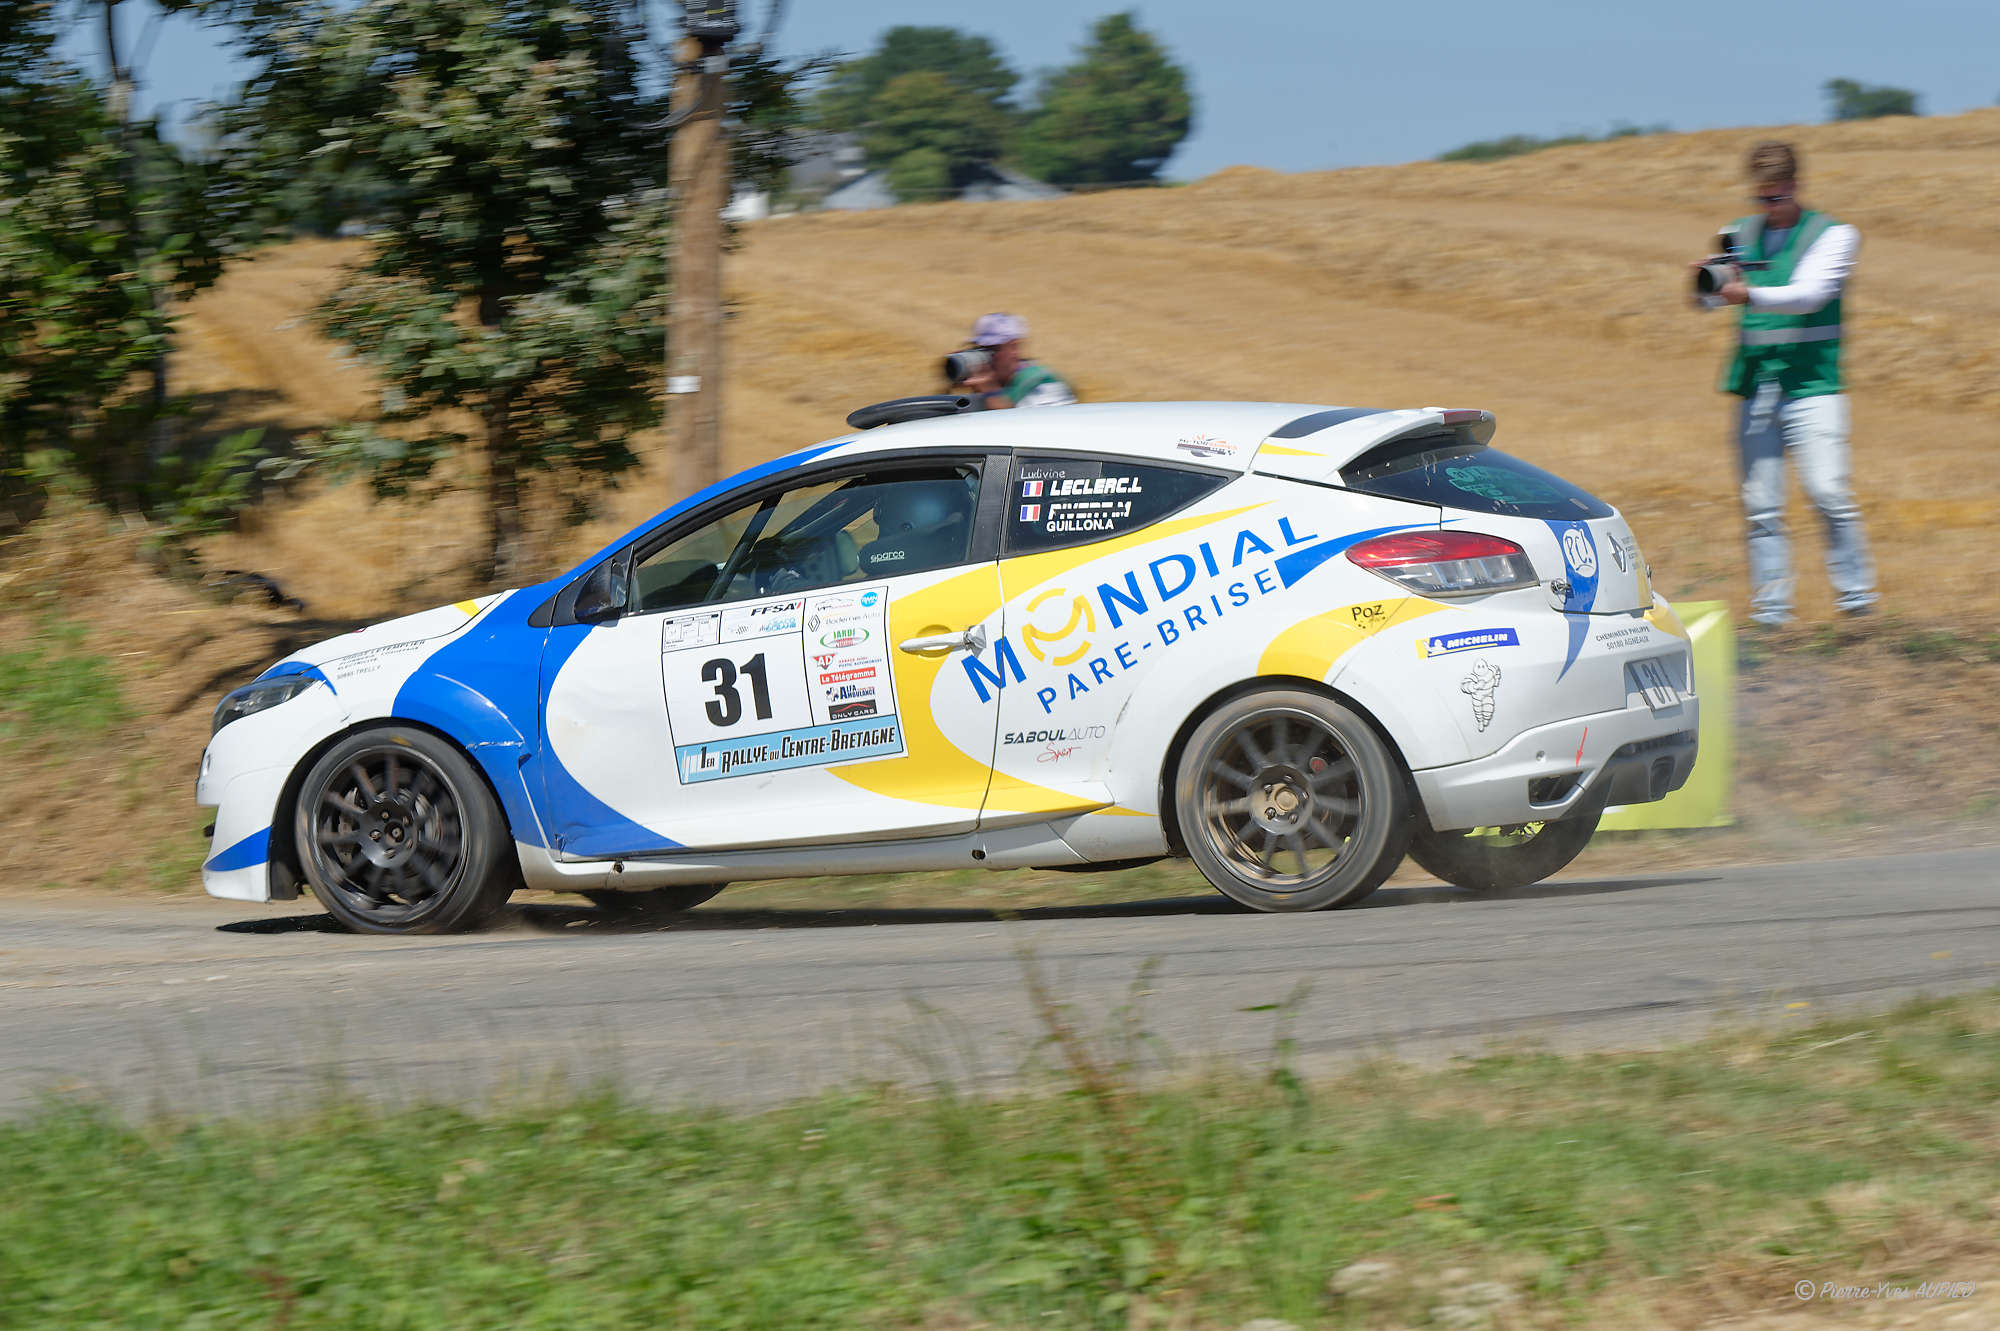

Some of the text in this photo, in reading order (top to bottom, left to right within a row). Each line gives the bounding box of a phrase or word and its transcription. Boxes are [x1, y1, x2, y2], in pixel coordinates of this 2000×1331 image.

[1021, 467, 1066, 480] Ludivine
[871, 551, 905, 563] sparco
[751, 603, 795, 616] FFSA
[961, 516, 1319, 704] MONDIAL
[1037, 568, 1277, 714] PARE-BRISE
[1446, 633, 1508, 649] MICHELIN
[831, 670, 875, 682] Télégramme
[701, 652, 773, 728] 31
[832, 708, 875, 720] ONLY CARS
[721, 745, 768, 774] RALLYE
[781, 727, 896, 759] CENTRE-BRETAGNE
